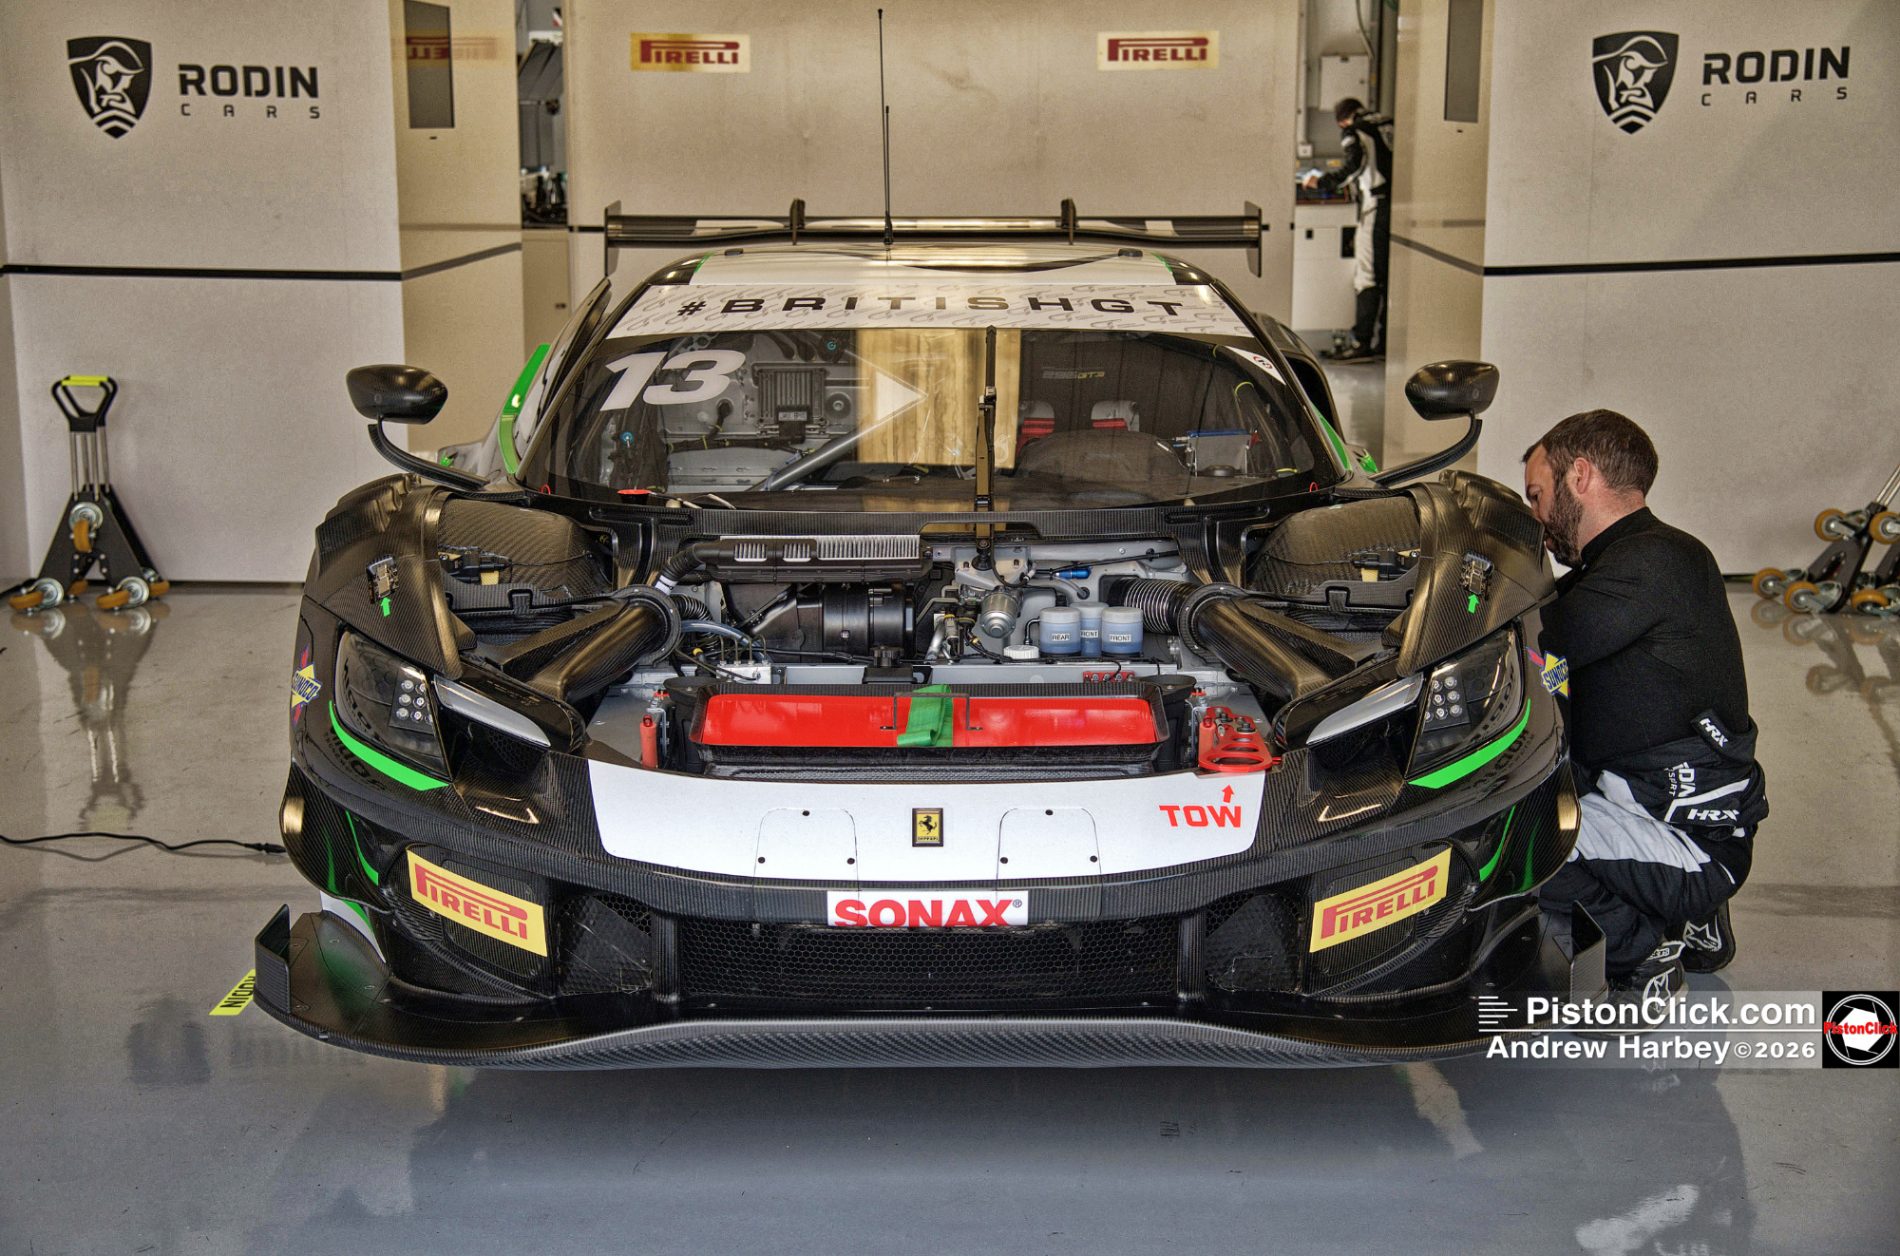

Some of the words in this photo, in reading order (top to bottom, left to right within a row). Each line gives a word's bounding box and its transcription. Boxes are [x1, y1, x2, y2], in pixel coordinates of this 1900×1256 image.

[640, 40, 740, 64] PIRELLI
[1108, 38, 1209, 61] PIRELLI
[1702, 46, 1850, 85] RODIN
[178, 64, 319, 98] RODIN
[1701, 86, 1848, 106] CARS
[181, 103, 320, 119] CARS
[677, 295, 1184, 318] #BRITISHGT
[600, 350, 746, 411] 13
[1699, 718, 1728, 748] HRX
[1159, 805, 1241, 828] TOW
[1687, 809, 1739, 821] HRX
[414, 863, 528, 939] PIRELLI
[1321, 865, 1438, 939] PIRELLI
